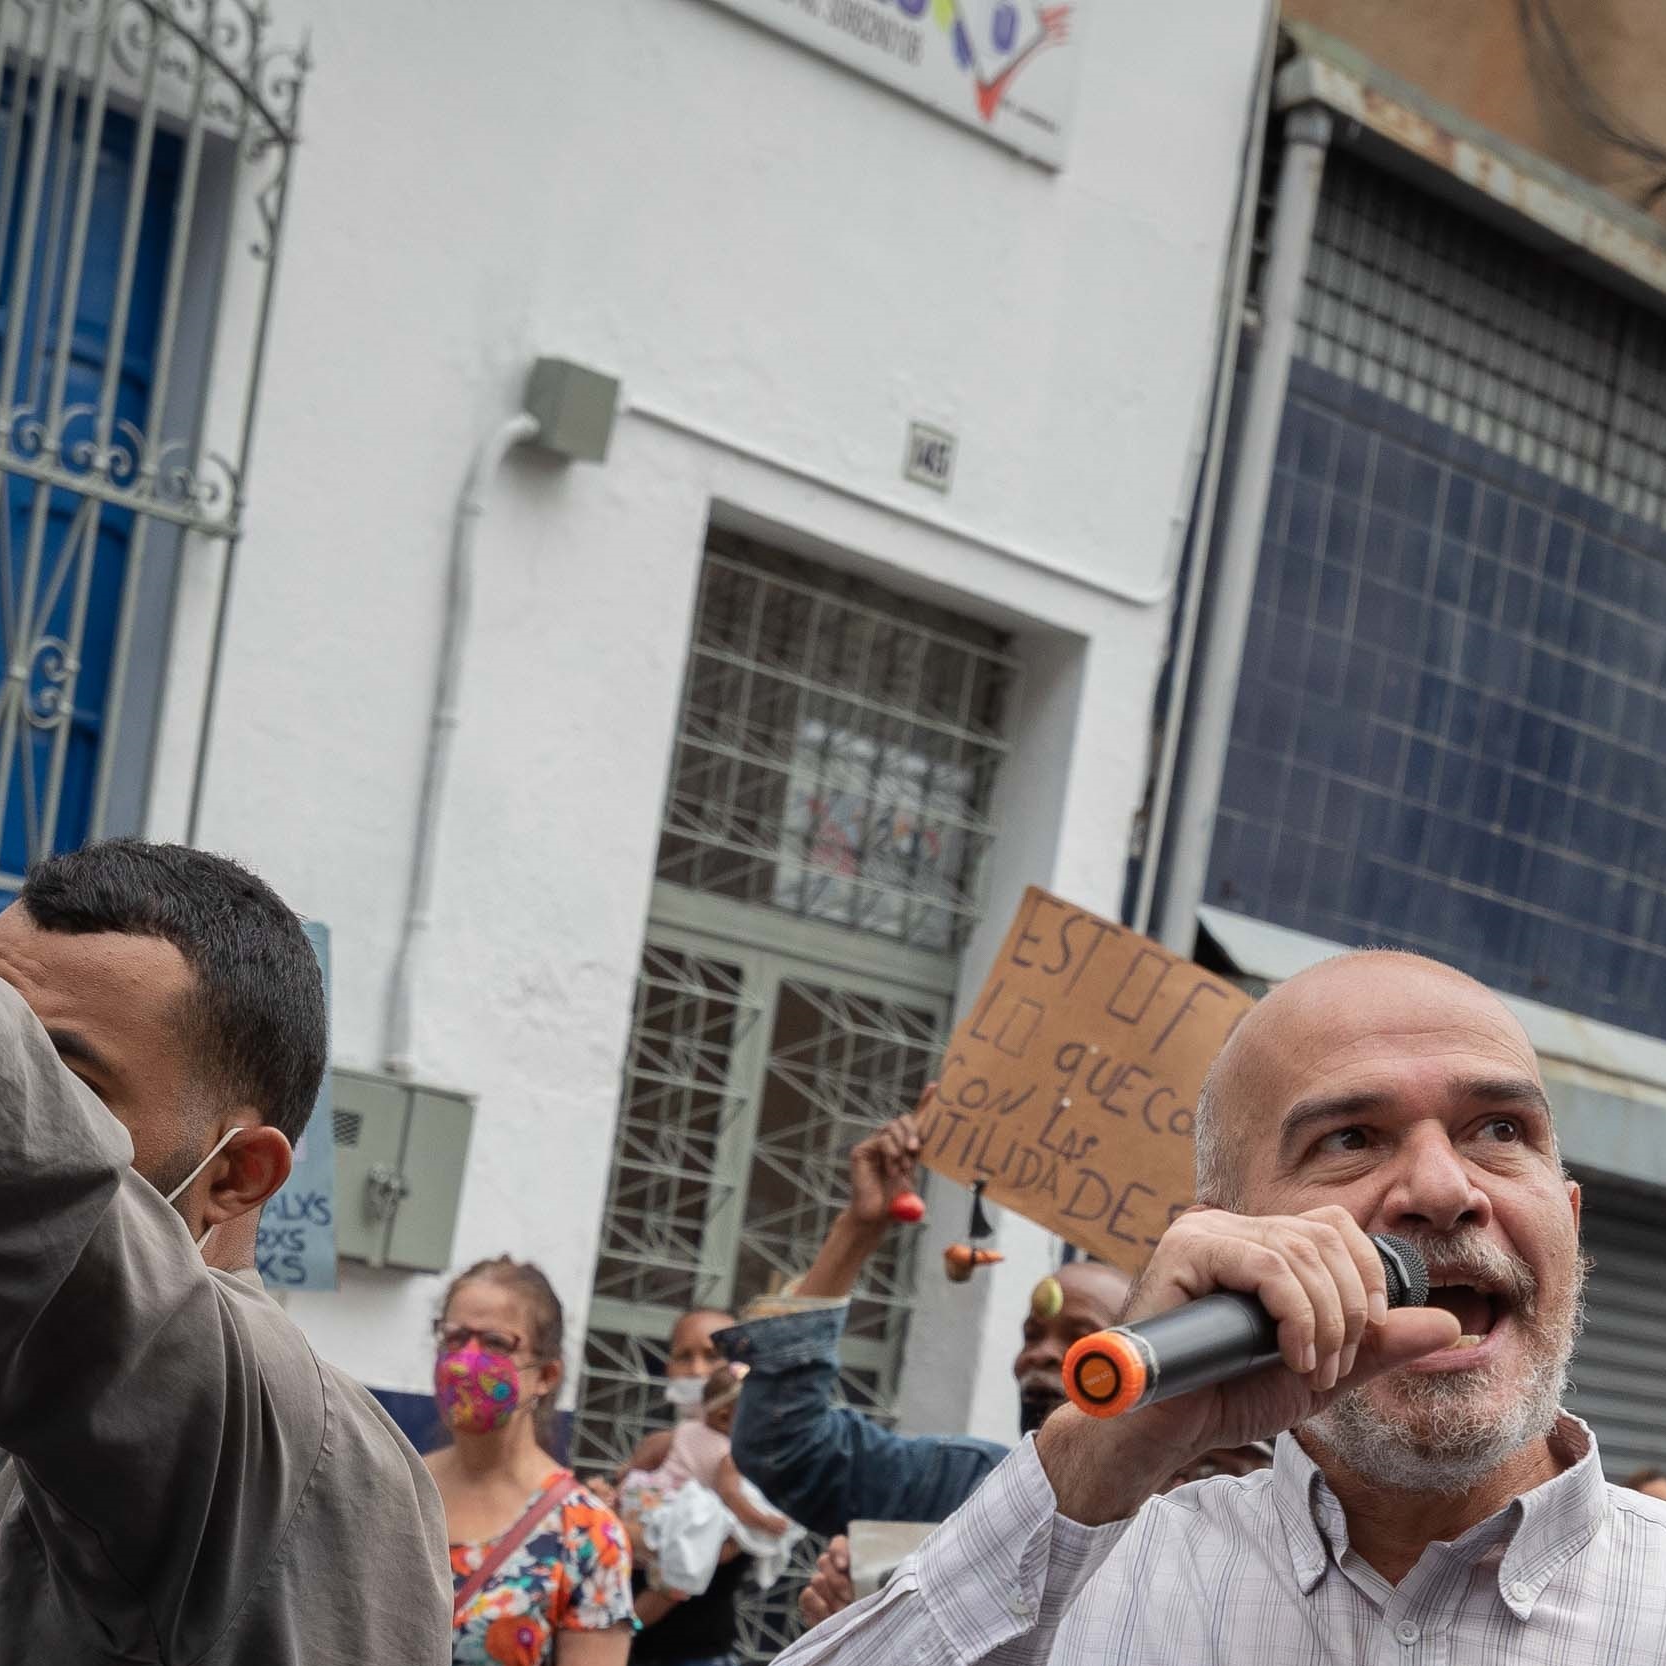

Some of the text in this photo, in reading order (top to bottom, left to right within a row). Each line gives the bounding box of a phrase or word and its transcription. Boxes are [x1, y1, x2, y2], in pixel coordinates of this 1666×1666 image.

[1011, 896, 1172, 1024] ESTO
[970, 981, 1045, 1059] LO
[937, 1056, 1038, 1116] CON
